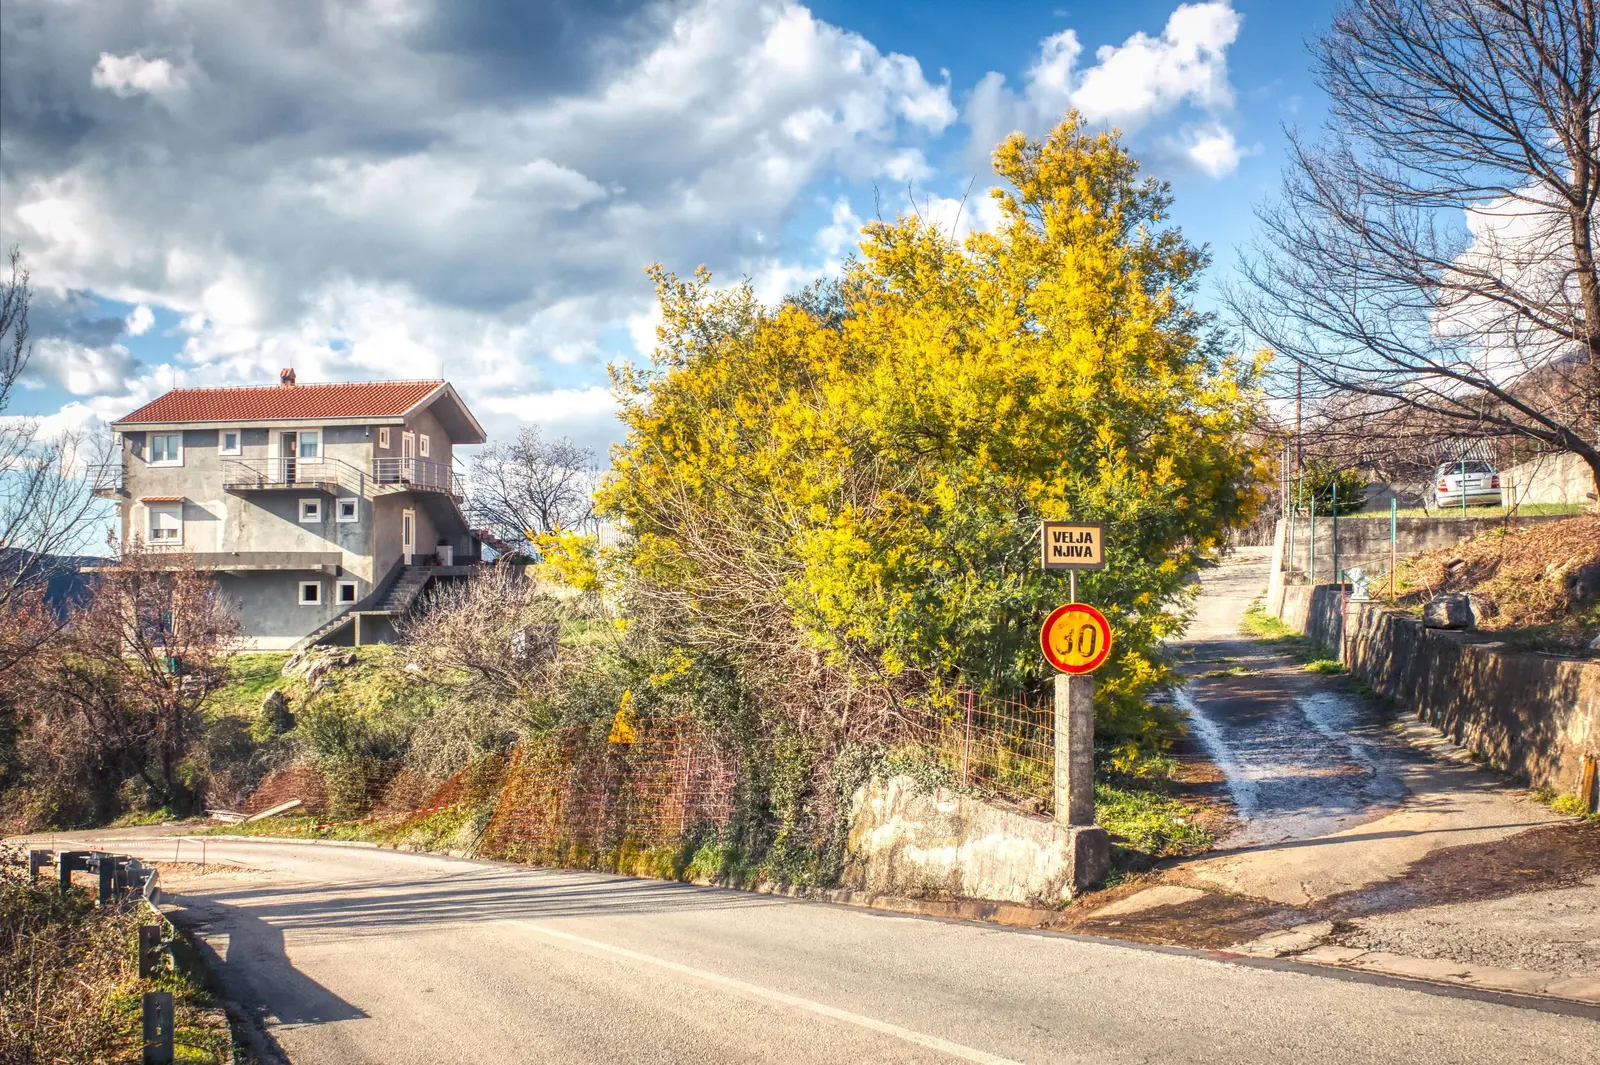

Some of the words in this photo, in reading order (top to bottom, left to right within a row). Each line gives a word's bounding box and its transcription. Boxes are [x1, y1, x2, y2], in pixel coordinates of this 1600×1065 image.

[1053, 531, 1093, 543] VELJA
[1053, 545, 1093, 557] NJIVA
[1055, 623, 1097, 658] 30
